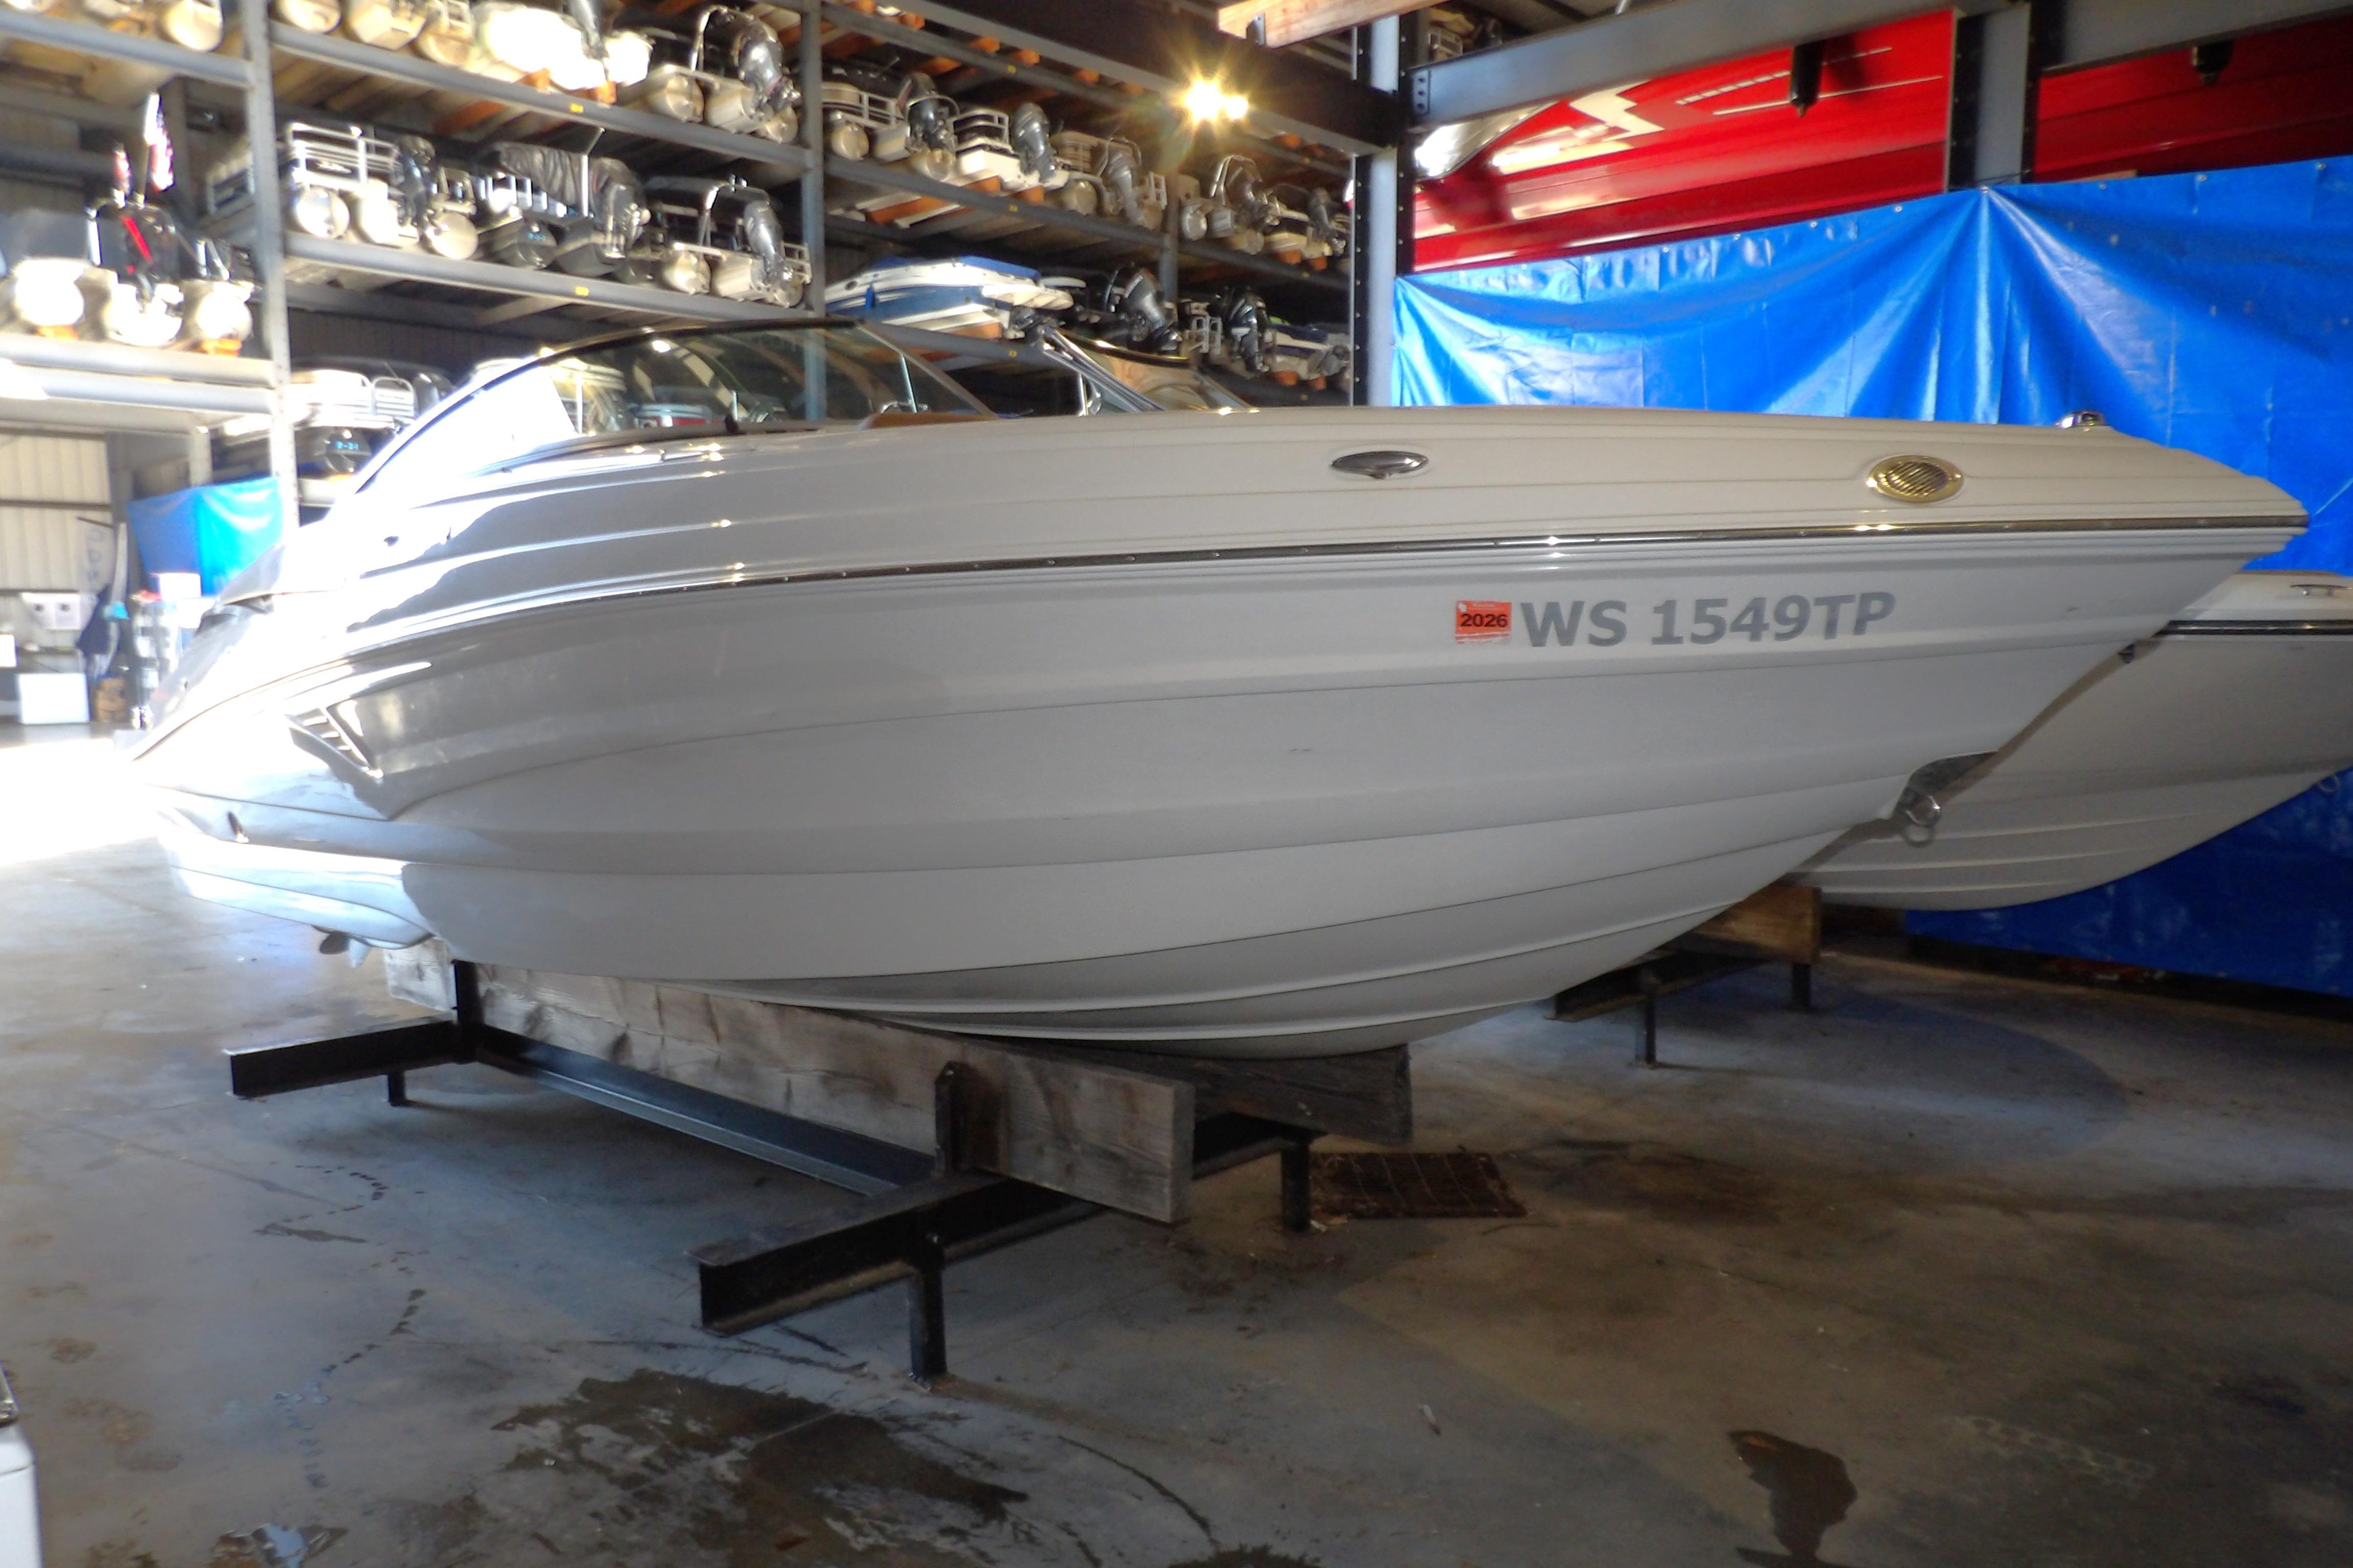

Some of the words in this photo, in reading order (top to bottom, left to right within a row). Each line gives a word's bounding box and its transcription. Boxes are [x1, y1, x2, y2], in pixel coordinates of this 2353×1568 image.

[1461, 613, 1508, 627] 2026
[1520, 601, 1628, 647] WS
[1652, 591, 1896, 645] 1549TP
